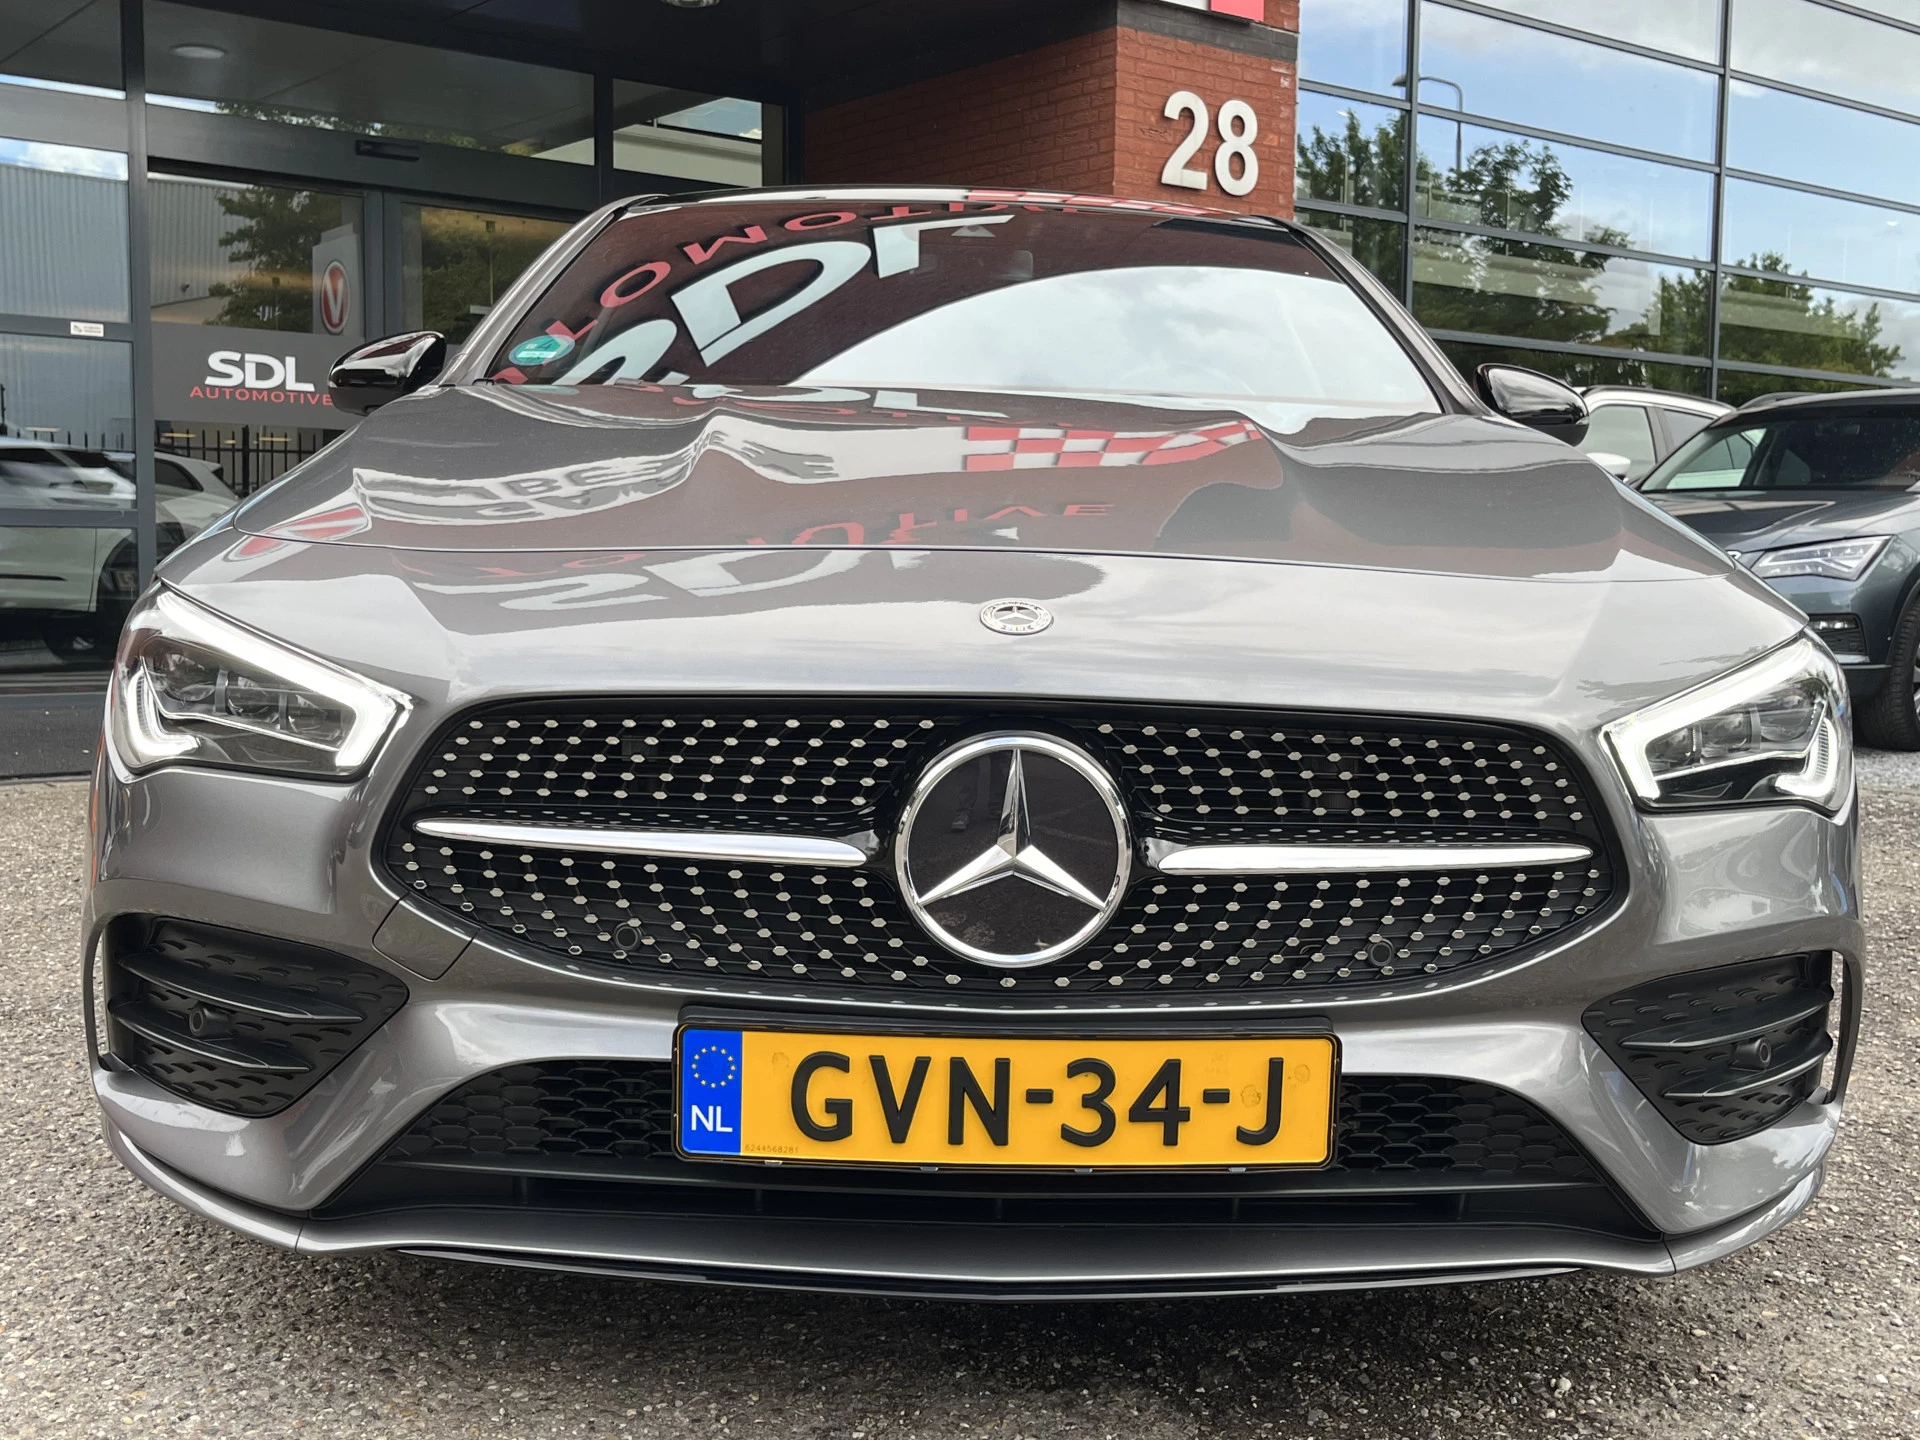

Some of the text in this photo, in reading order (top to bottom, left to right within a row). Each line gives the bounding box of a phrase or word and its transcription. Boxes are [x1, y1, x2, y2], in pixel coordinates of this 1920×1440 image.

[1161, 90, 1259, 196] 28
[204, 350, 315, 392] SDL
[190, 386, 333, 405] AUTOMOTIVE
[691, 1104, 733, 1133] NL
[790, 1050, 1284, 1148] GVN-34-J
